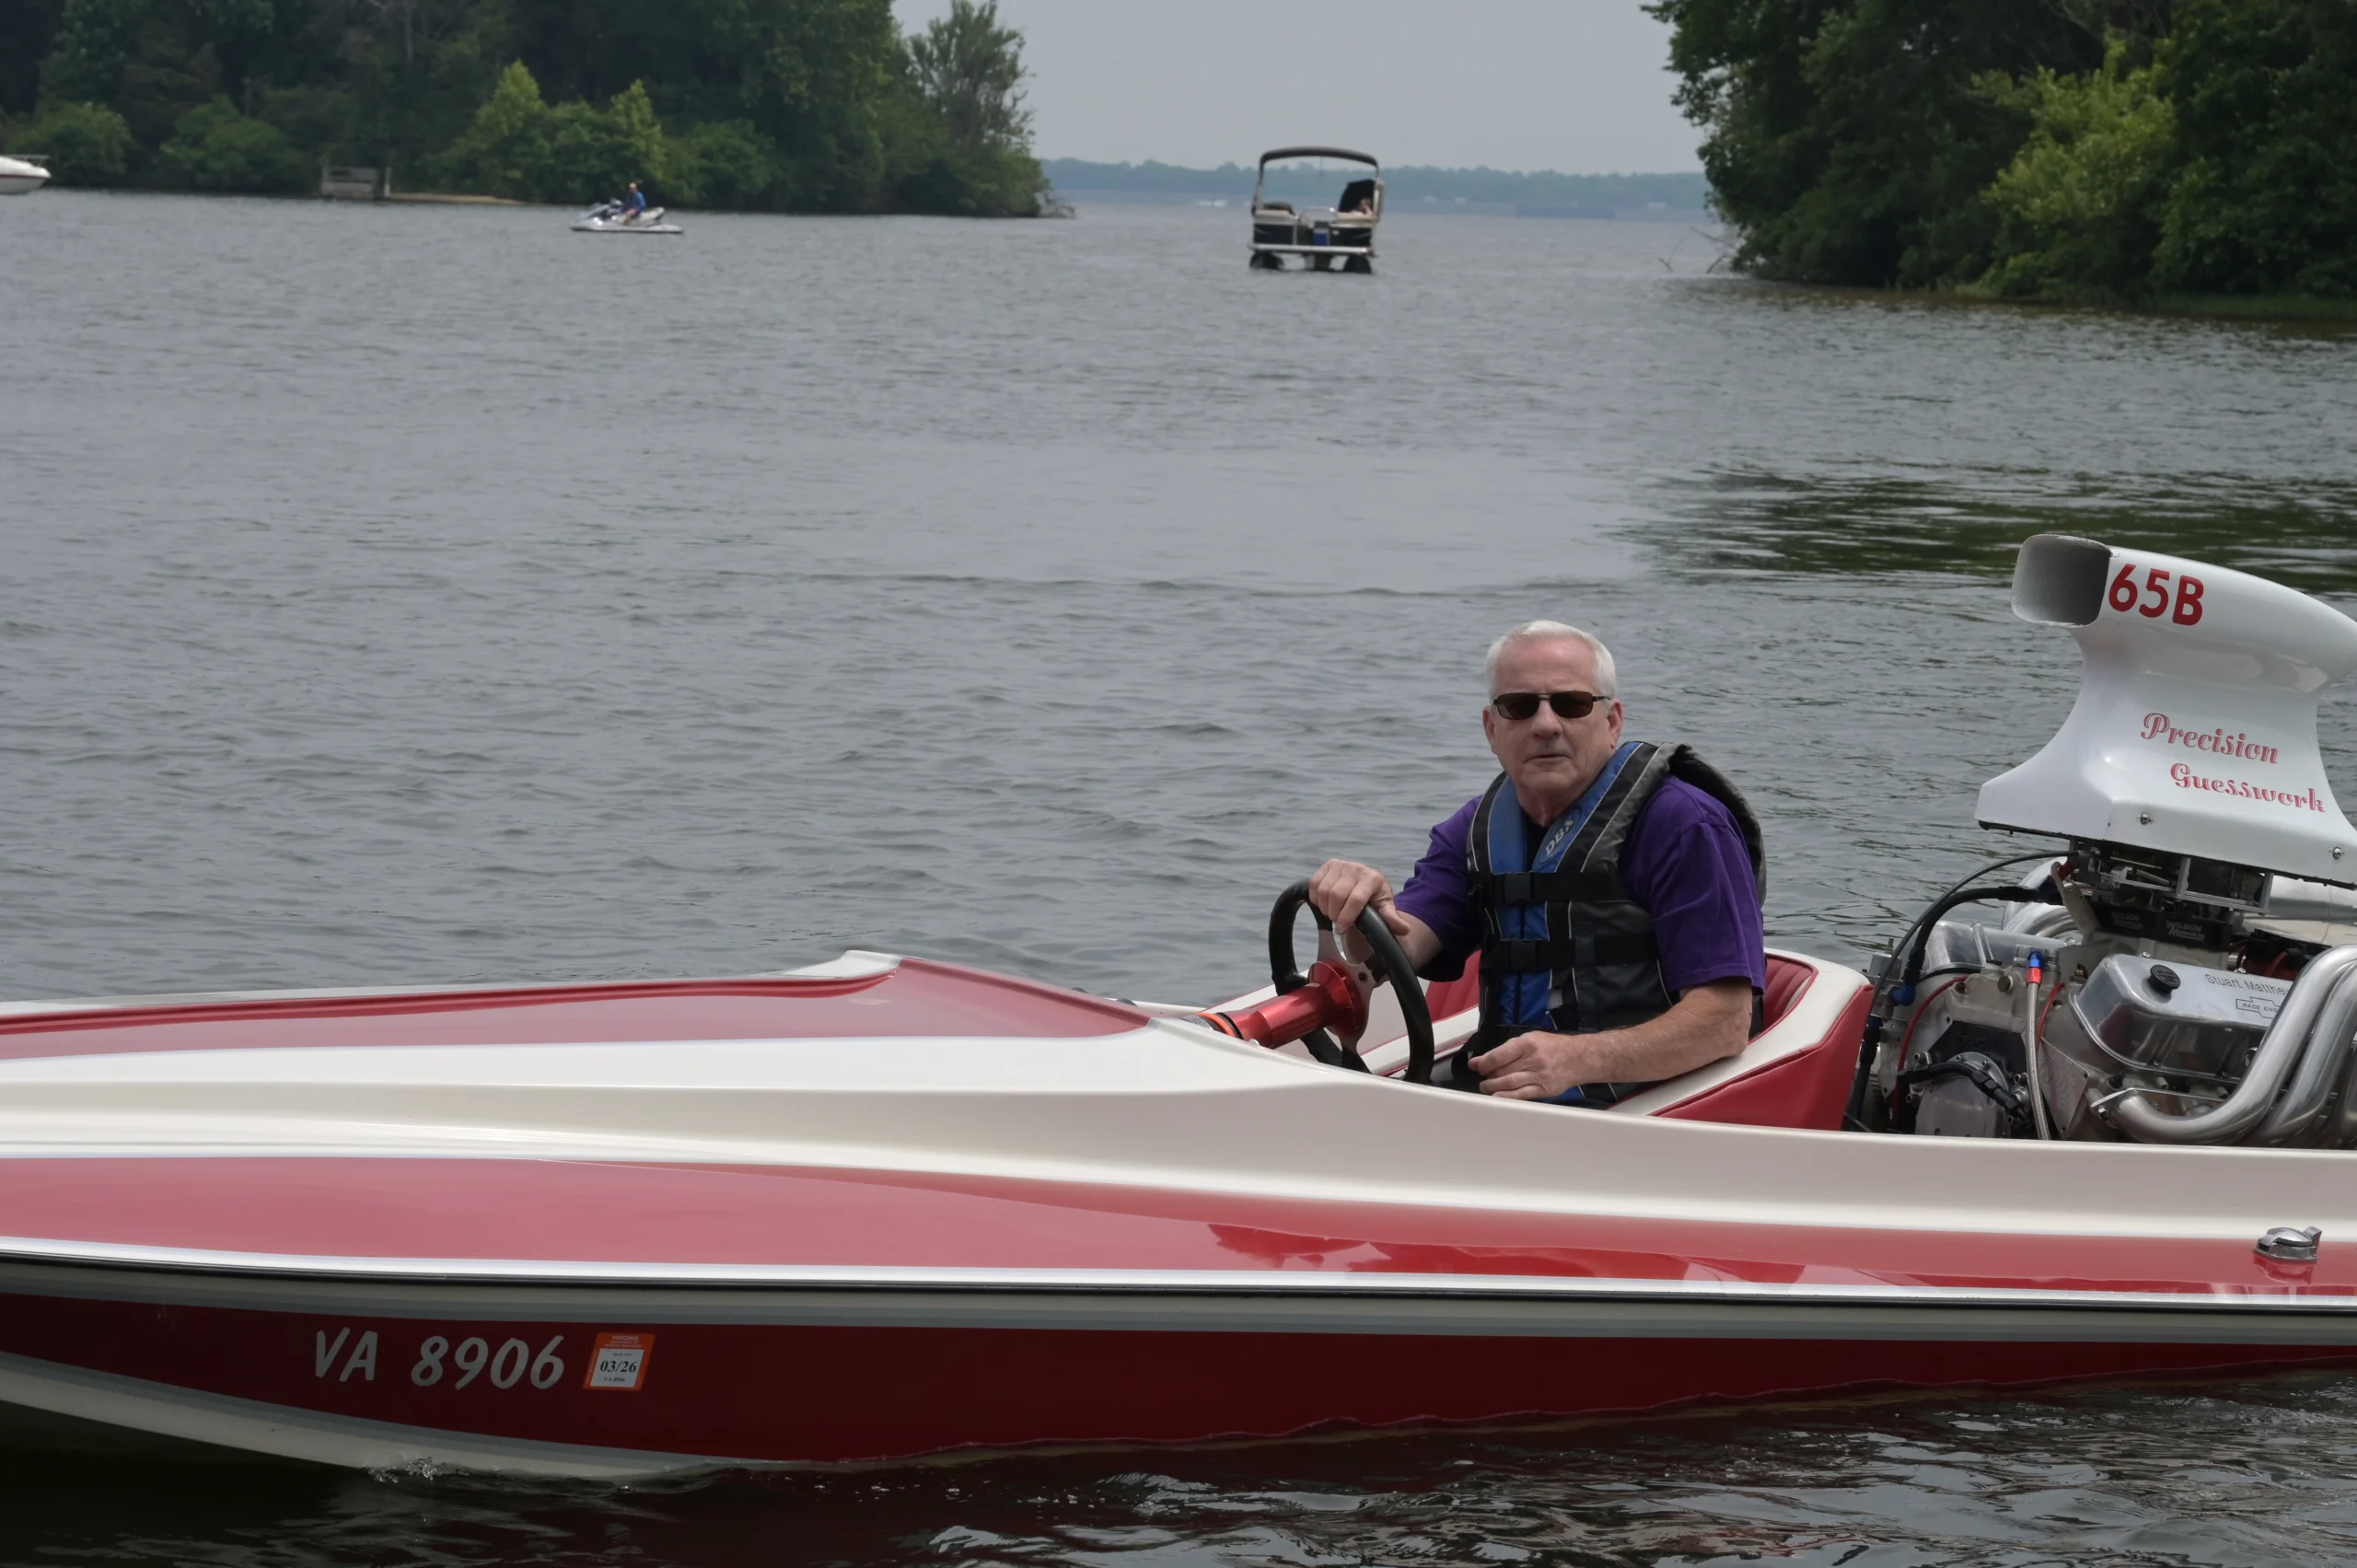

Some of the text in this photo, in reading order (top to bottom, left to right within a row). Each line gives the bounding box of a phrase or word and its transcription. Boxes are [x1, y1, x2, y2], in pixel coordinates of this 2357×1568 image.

[2108, 563, 2204, 626] 65B
[2141, 713, 2278, 764] Precision
[2170, 762, 2325, 812] Guesswork
[2165, 920, 2202, 932] WILSON
[2205, 973, 2243, 989] Stuart
[315, 1327, 378, 1382] VA
[411, 1335, 564, 1389] 8906
[599, 1360, 638, 1373] 03/26
